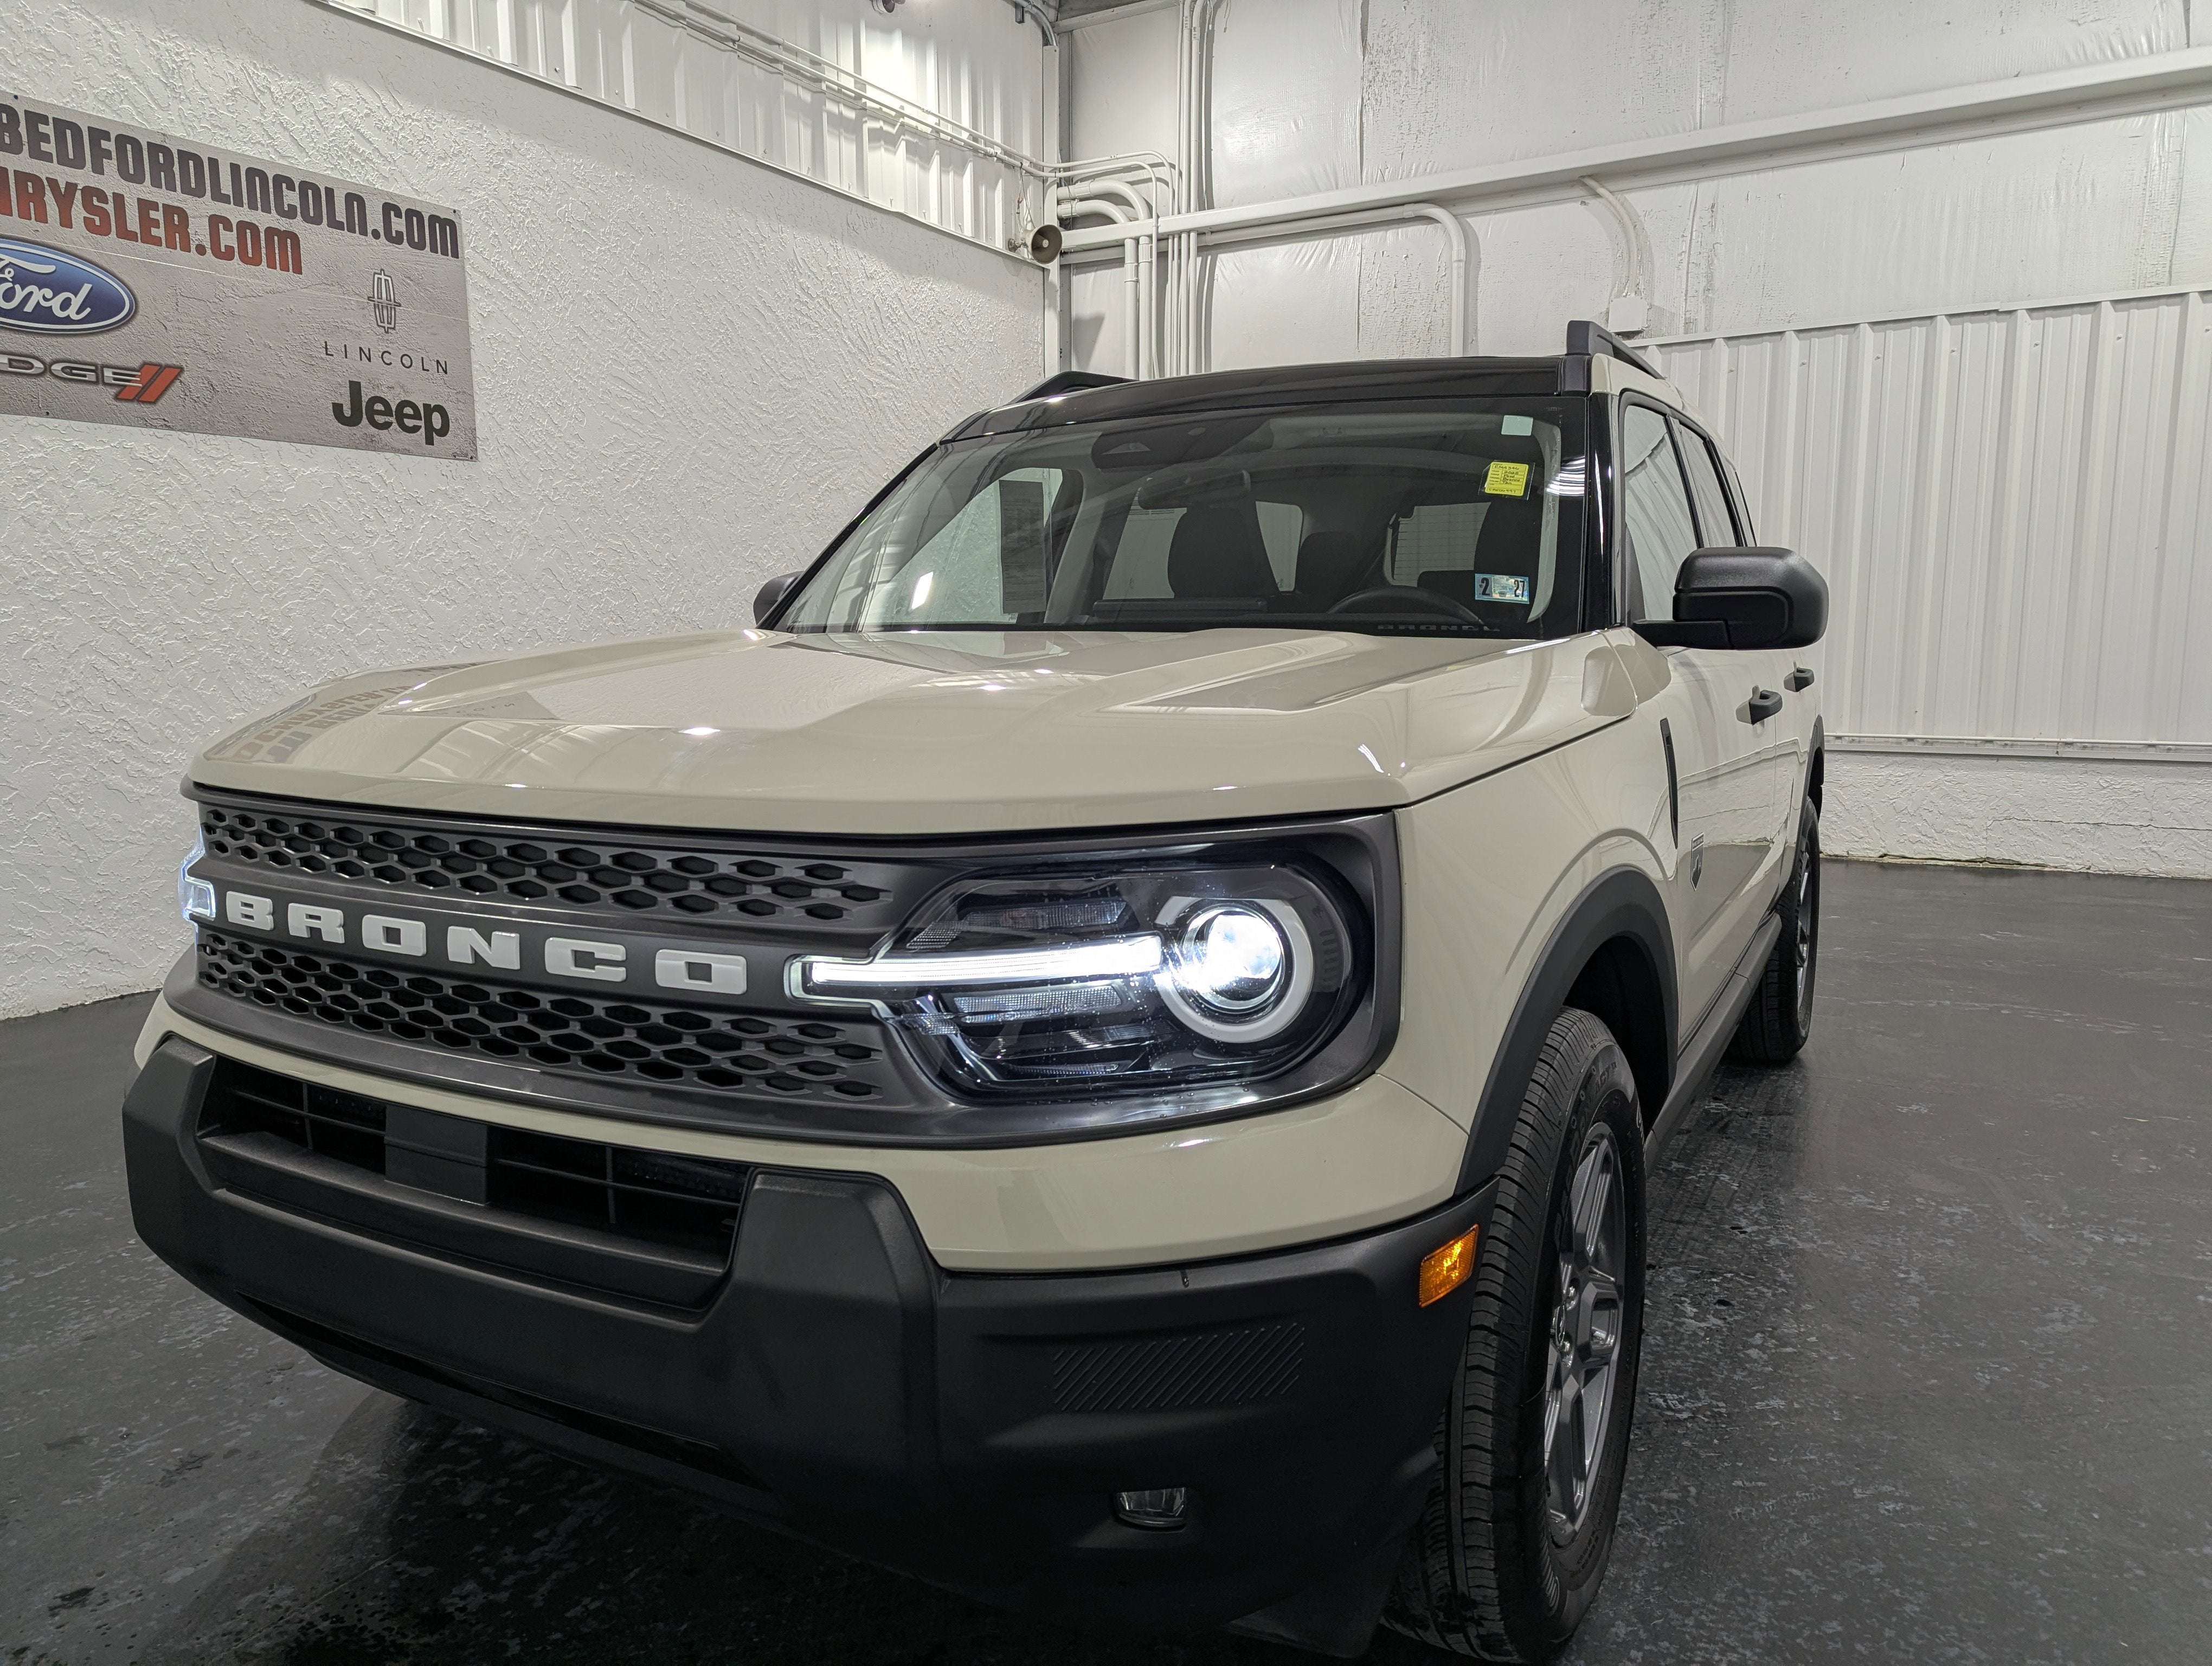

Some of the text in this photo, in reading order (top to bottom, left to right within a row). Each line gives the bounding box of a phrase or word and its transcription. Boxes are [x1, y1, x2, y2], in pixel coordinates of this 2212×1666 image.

[325, 341, 448, 375] LINCOLN
[332, 380, 450, 446] Jeep
[1481, 577, 1490, 596] 2
[1514, 579, 1525, 598] 27
[225, 890, 748, 995] BRONCO
